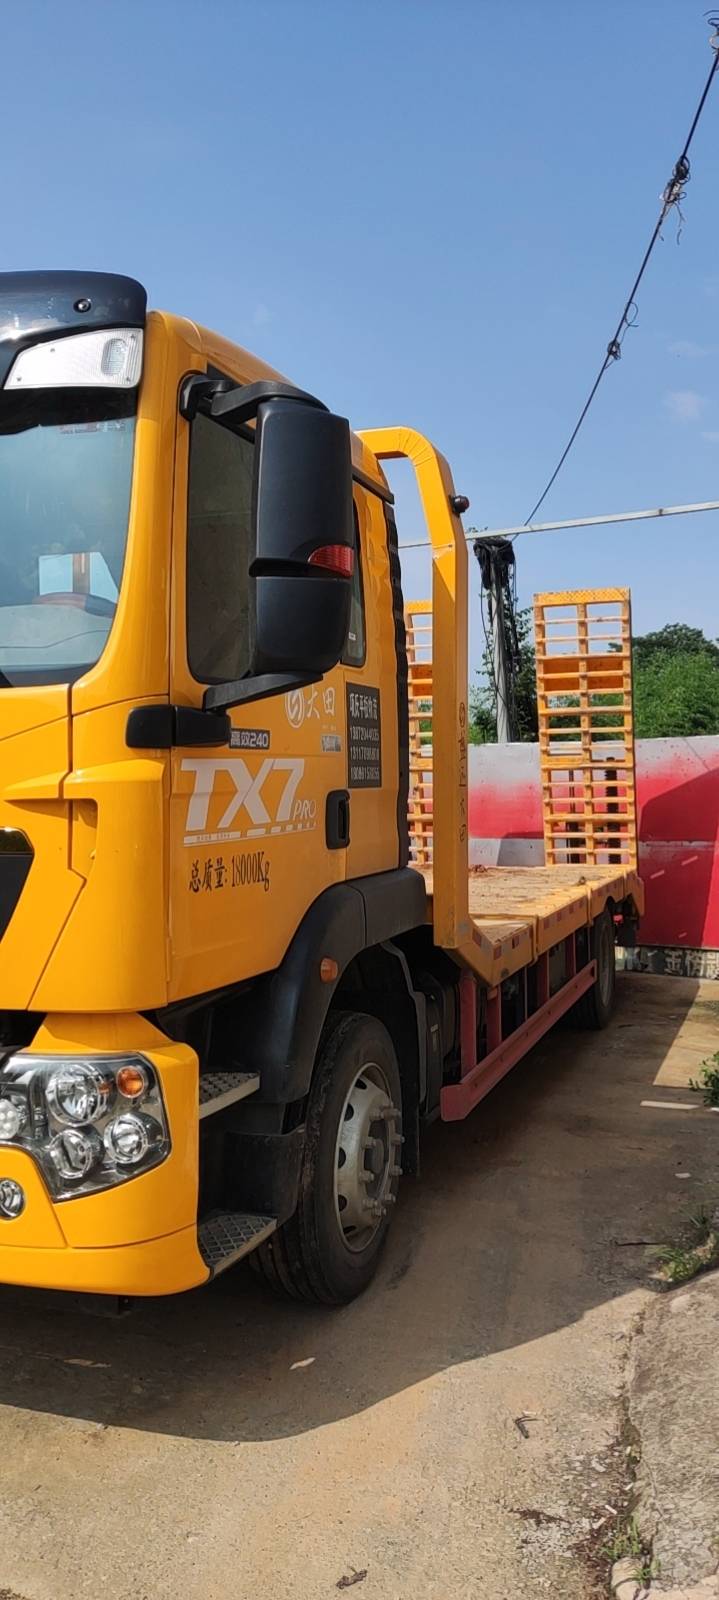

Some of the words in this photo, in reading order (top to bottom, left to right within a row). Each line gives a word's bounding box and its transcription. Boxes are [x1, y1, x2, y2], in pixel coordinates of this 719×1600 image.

[307, 684, 336, 719] 大田
[181, 758, 304, 832] TX7
[293, 799, 317, 822] PRO
[189, 857, 228, 893] 总质量:
[231, 851, 270, 892] 18000Kg
